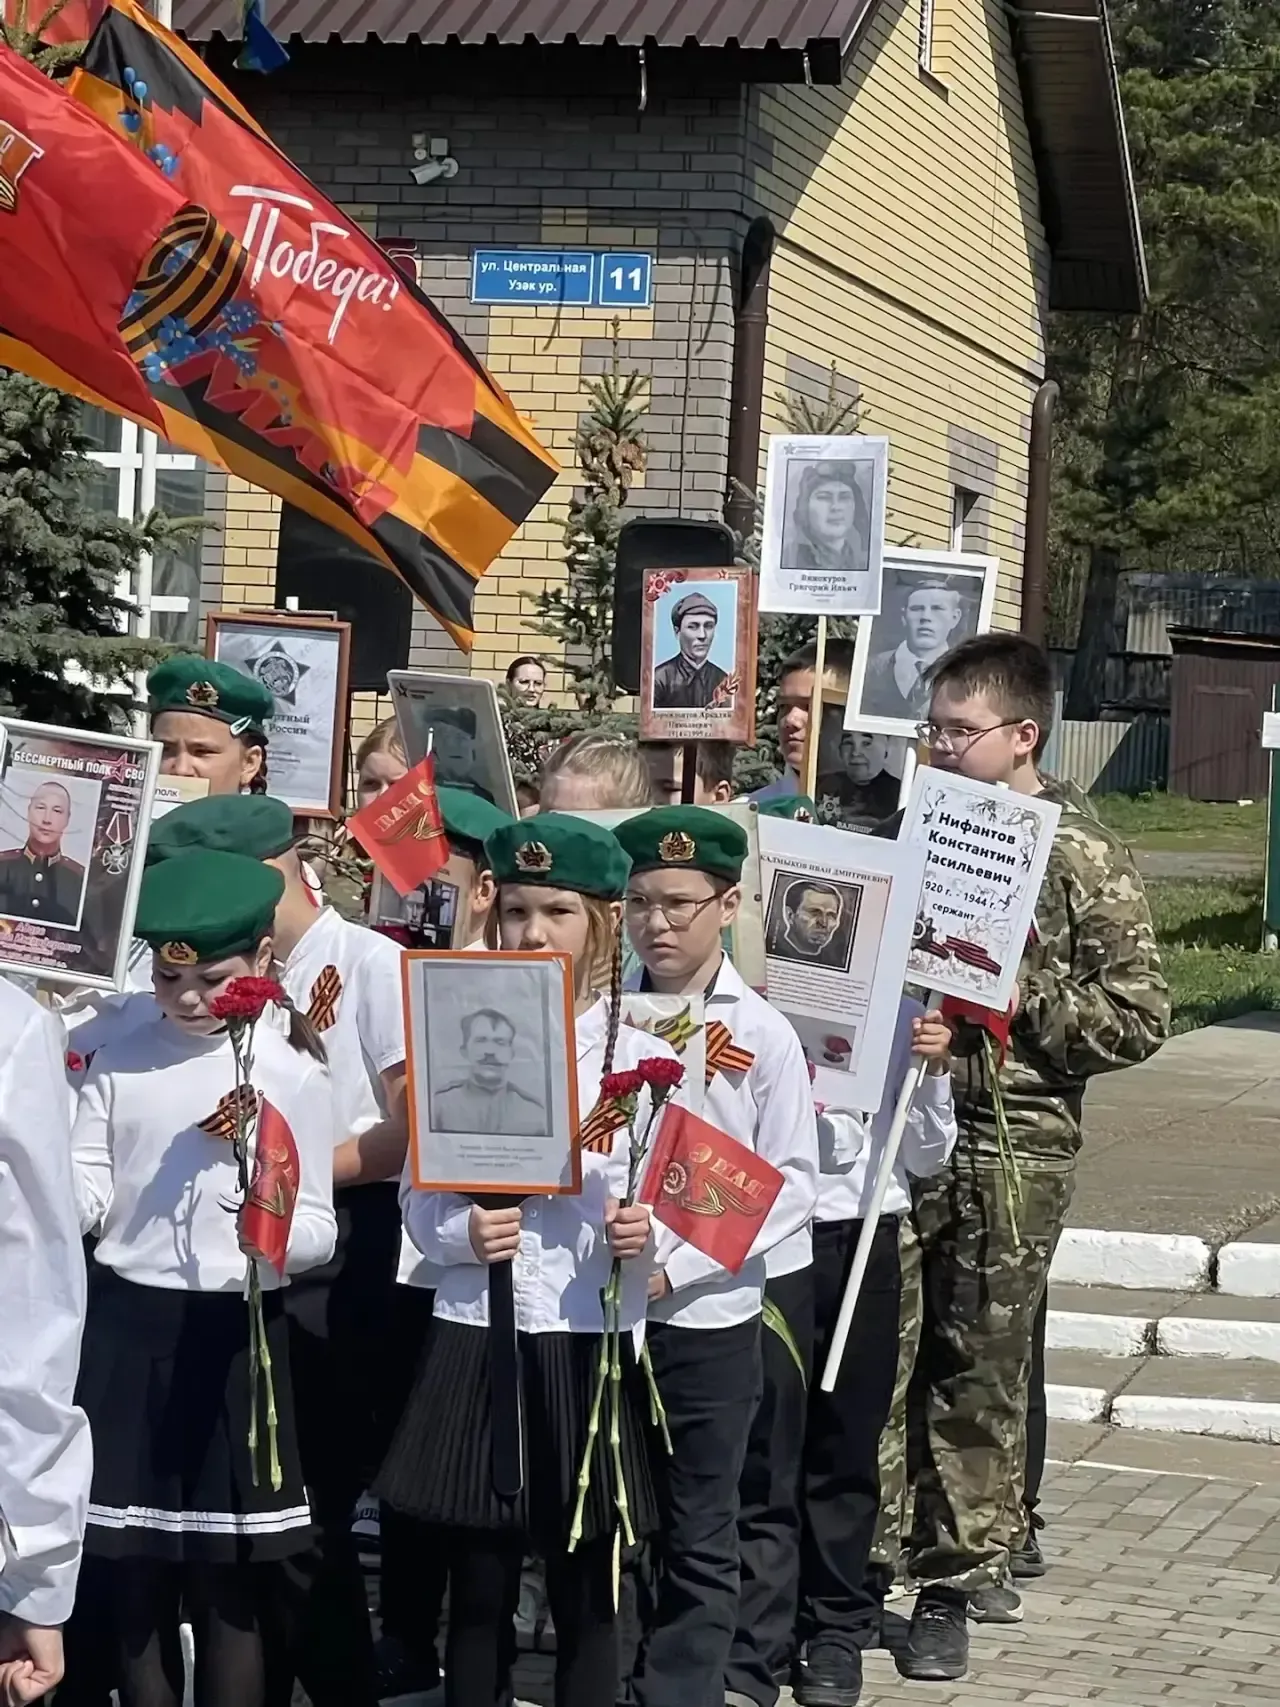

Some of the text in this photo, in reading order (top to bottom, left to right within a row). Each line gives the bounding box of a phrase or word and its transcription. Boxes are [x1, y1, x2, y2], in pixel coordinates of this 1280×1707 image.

[229, 185, 399, 345] Победа!
[481, 260, 587, 274] ул. Центральная
[610, 267, 641, 291] 11
[538, 281, 557, 292] ур.
[13, 750, 145, 781] БЕССМЕРТНЫЙ ПОЛК СВО
[938, 811, 1016, 845] Нифантов
[928, 829, 1016, 866] Константин
[760, 854, 889, 884] КАЛМЫКОВ ИВАН ДМИТРИЕВИЧ
[932, 902, 976, 921] сержант
[963, 892, 987, 907] 1944
[709, 1157, 764, 1199] МАЯ
